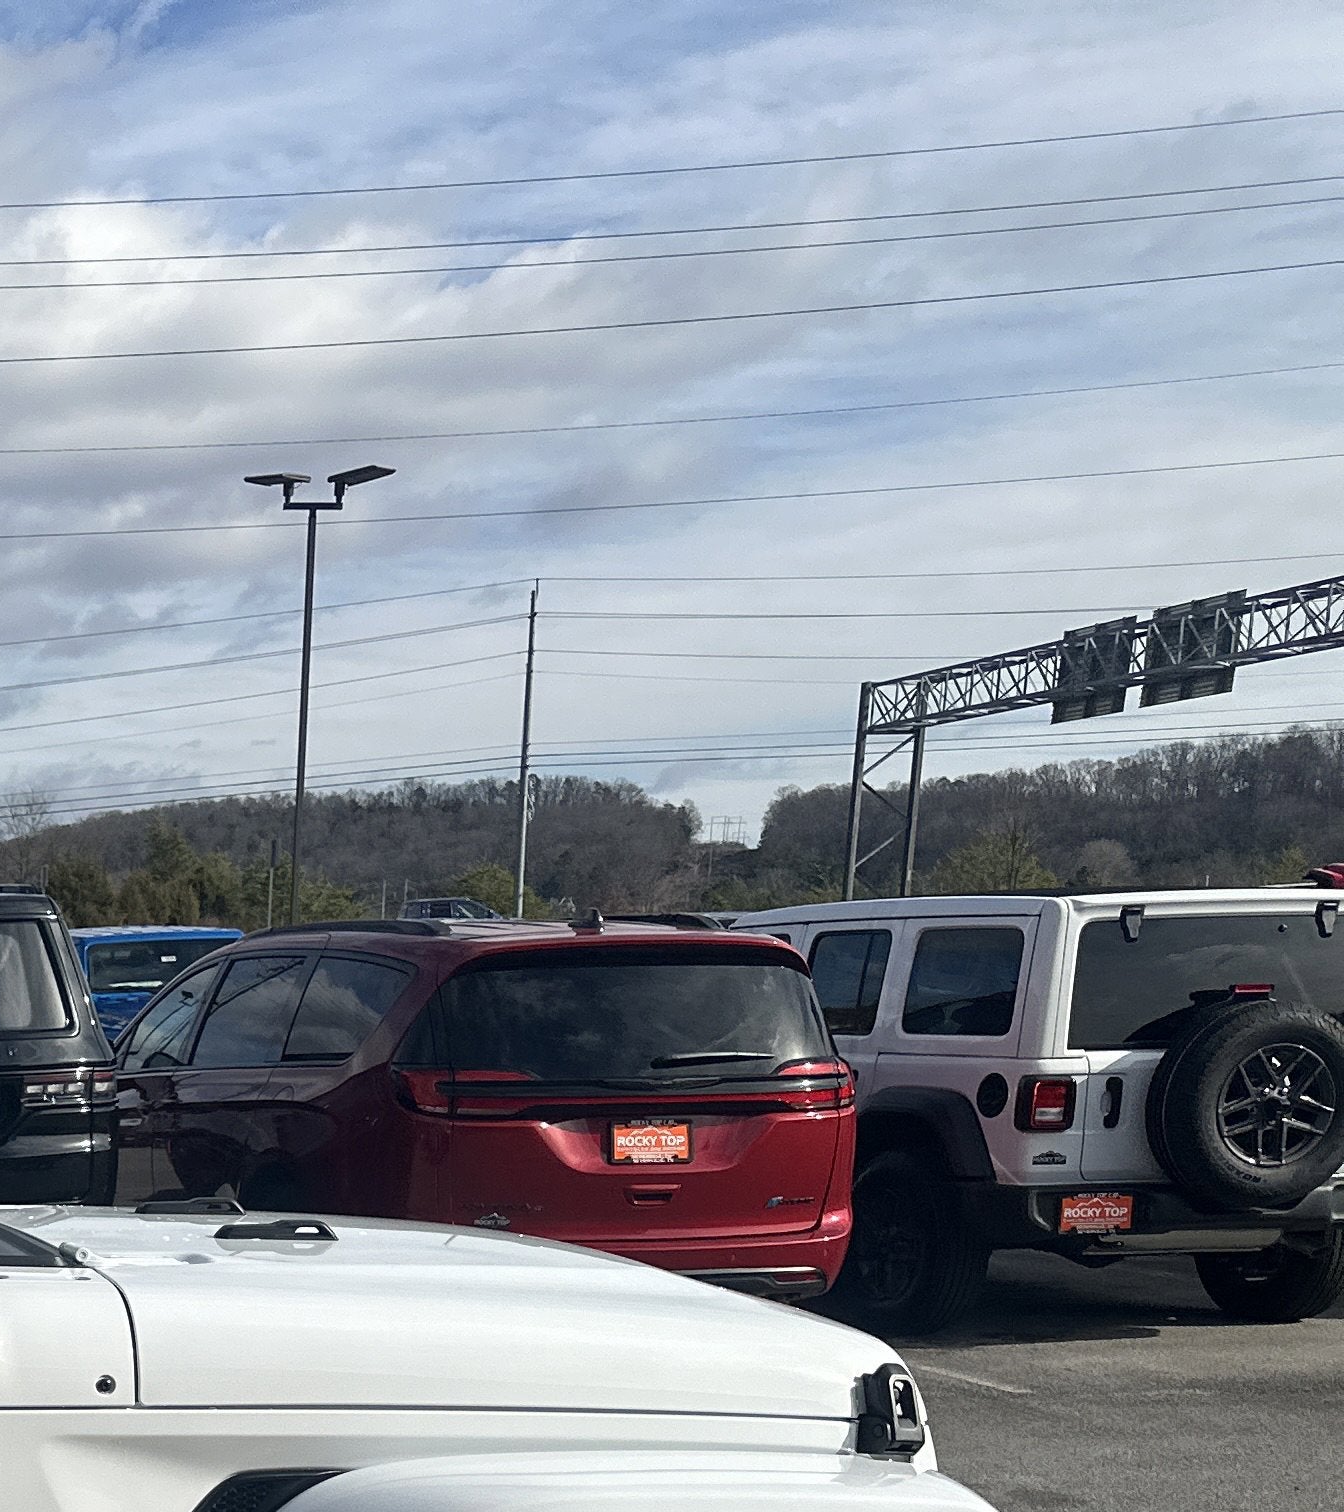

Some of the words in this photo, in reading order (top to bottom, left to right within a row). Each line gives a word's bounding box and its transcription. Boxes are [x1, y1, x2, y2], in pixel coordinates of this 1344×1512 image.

[617, 1135, 658, 1147] ROCKY
[659, 1135, 685, 1146] TOP
[1063, 1207, 1102, 1218] ROCKY
[1104, 1207, 1128, 1217] TOP
